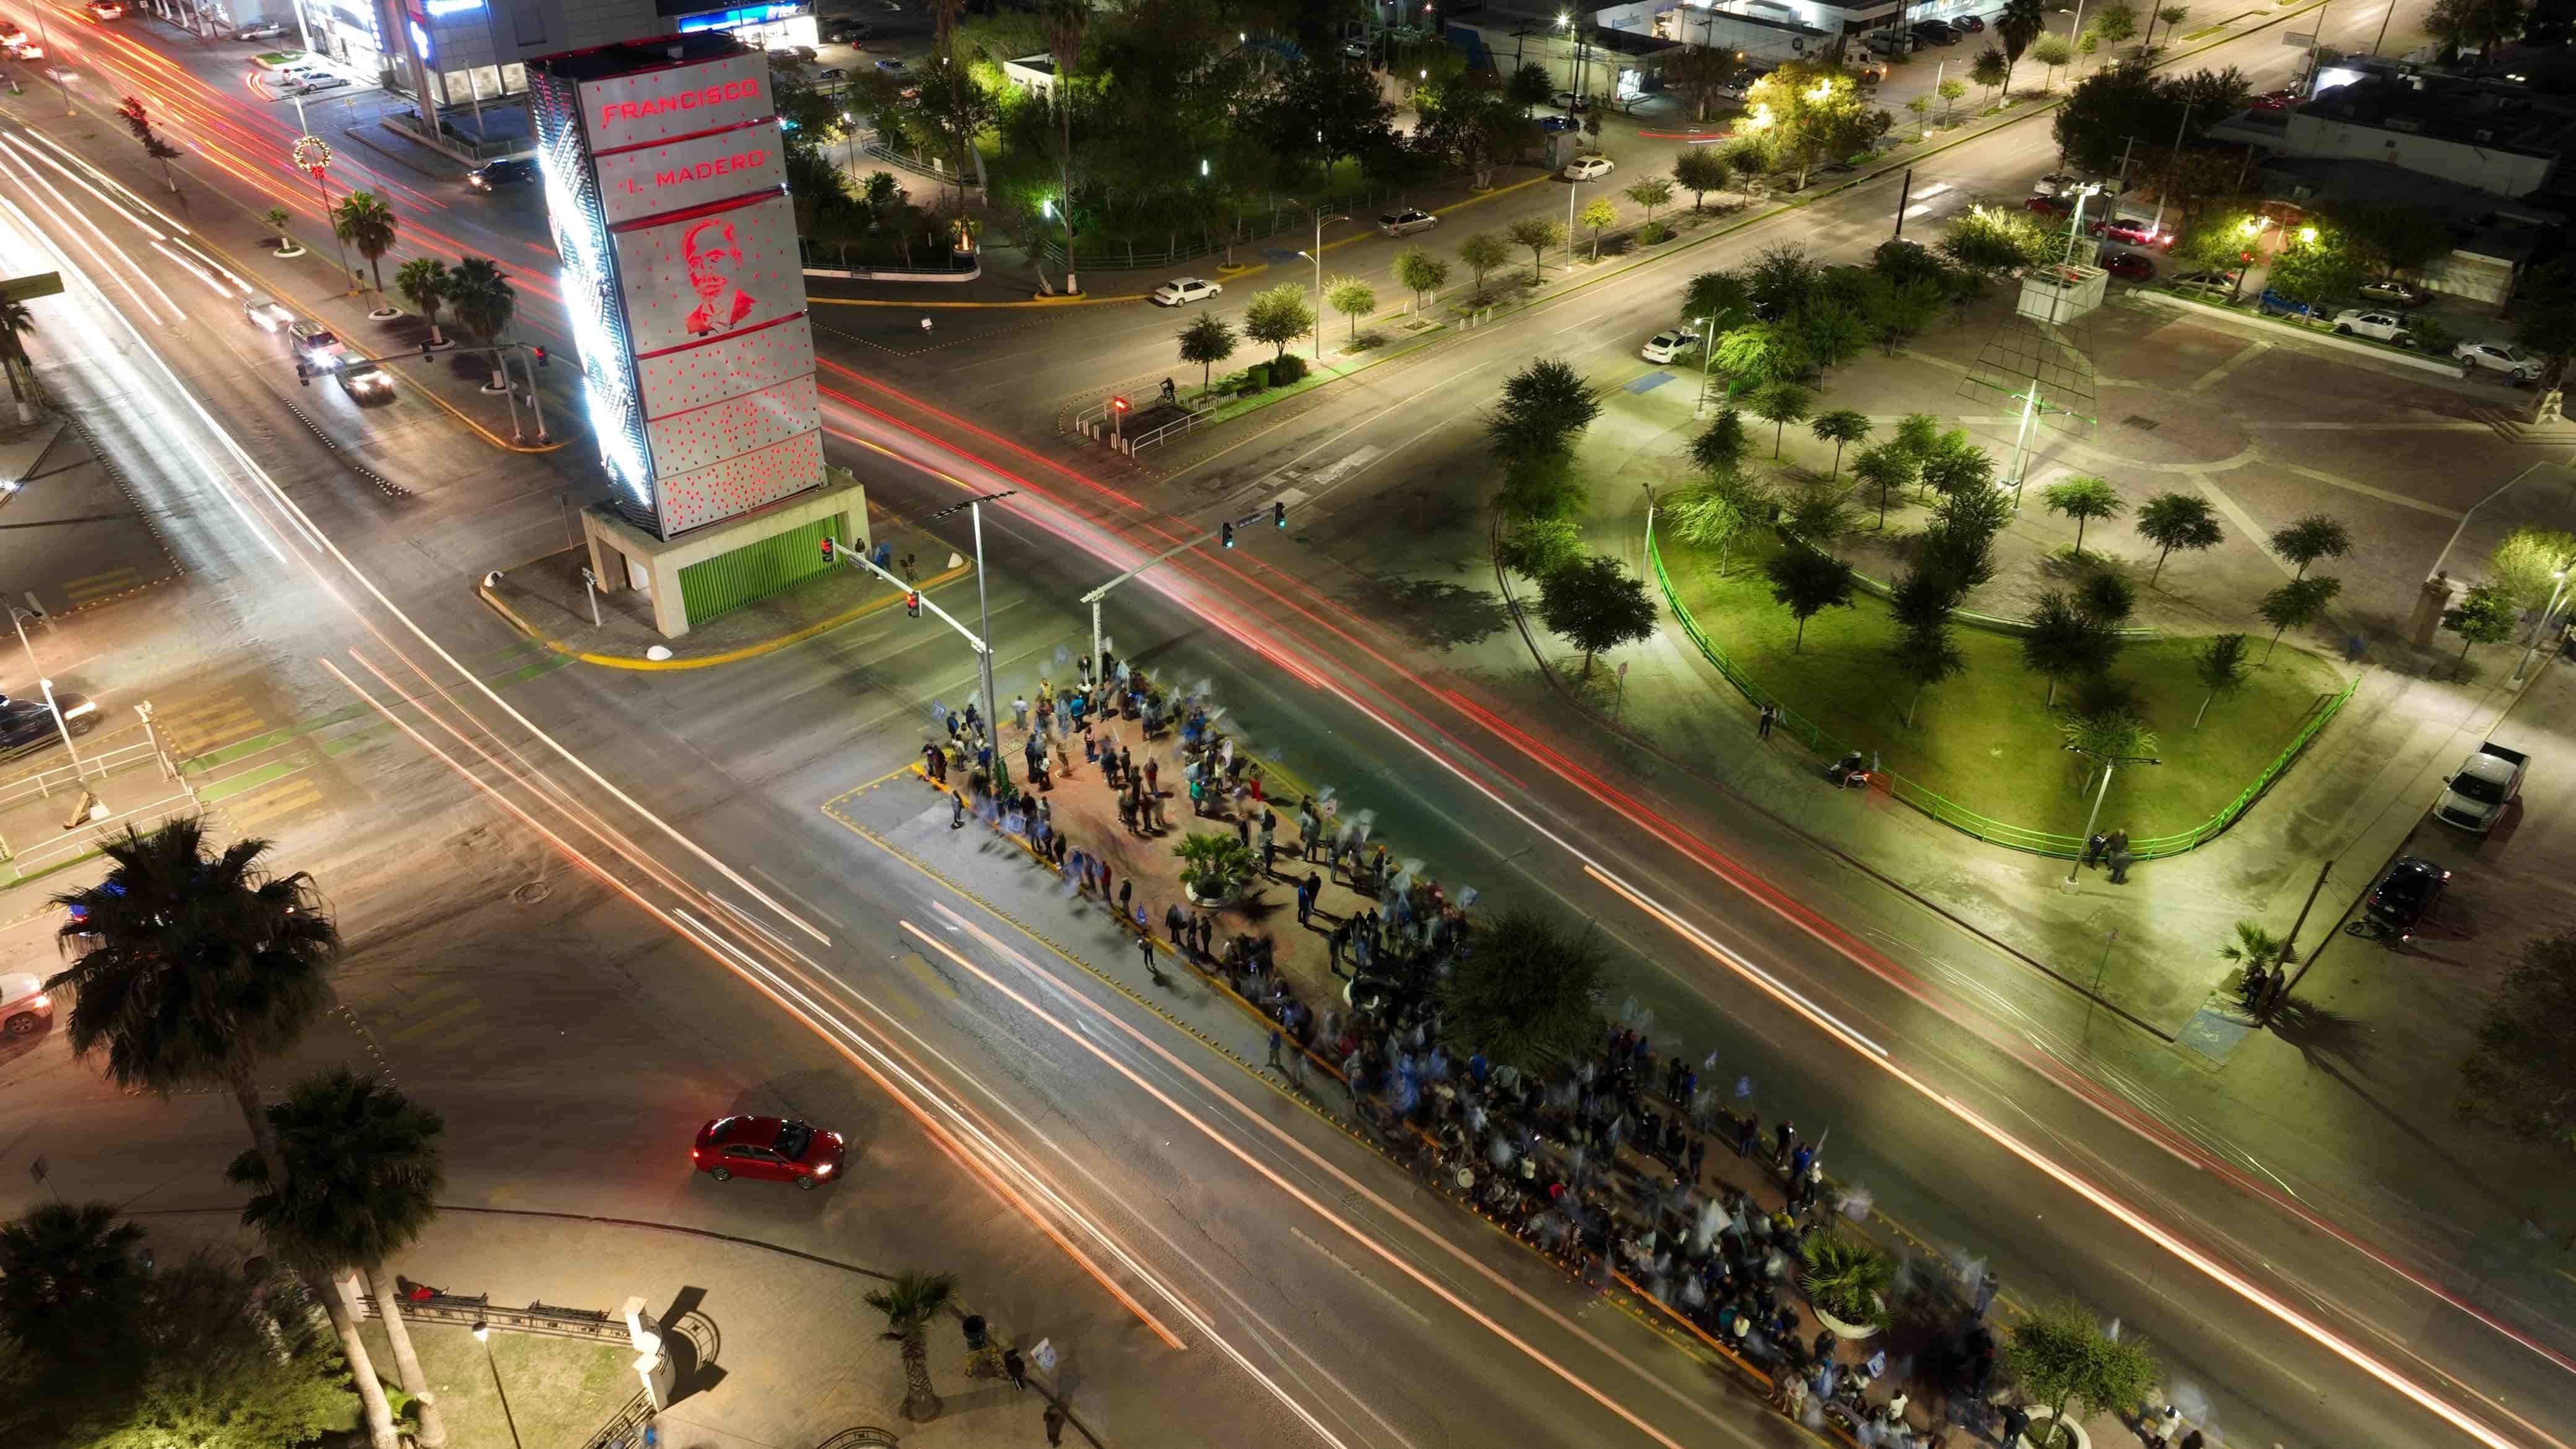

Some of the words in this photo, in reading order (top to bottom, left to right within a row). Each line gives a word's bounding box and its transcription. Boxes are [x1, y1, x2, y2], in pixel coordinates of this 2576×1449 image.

[602, 79, 758, 124] FRANCISCO
[627, 178, 643, 193] I.
[656, 150, 764, 187] MADERO
